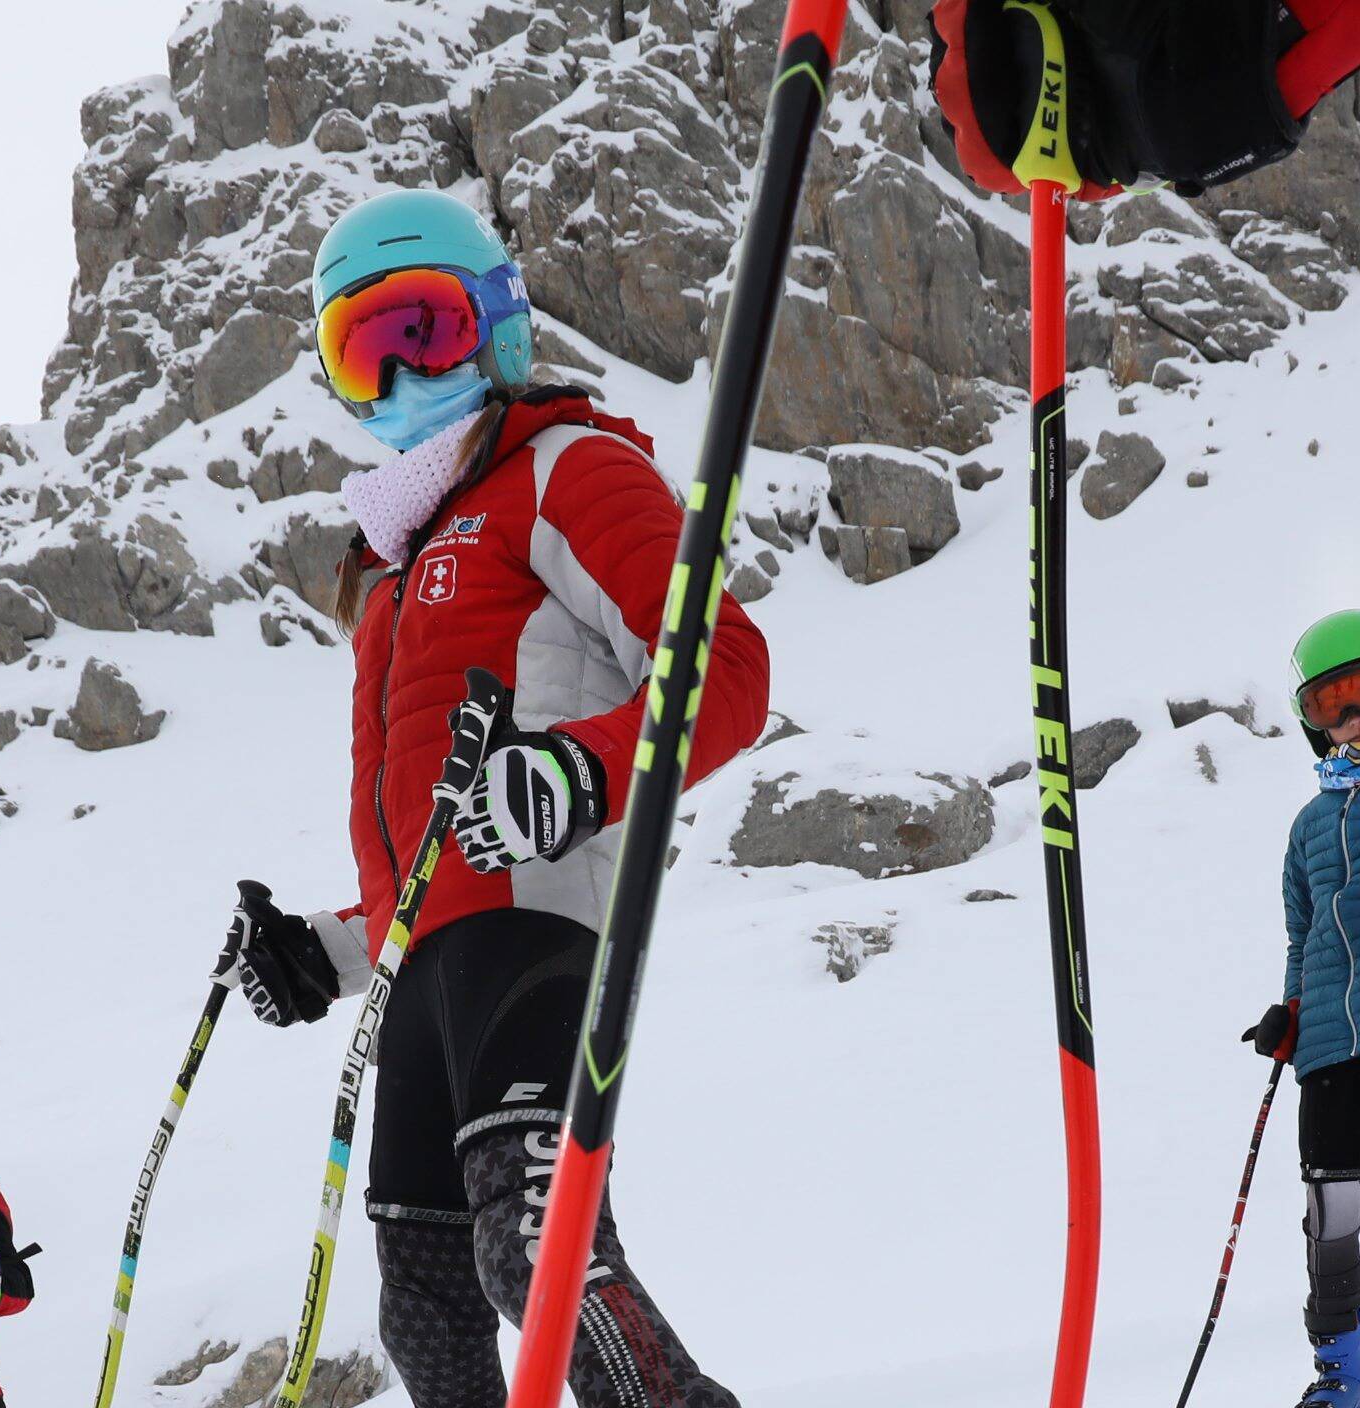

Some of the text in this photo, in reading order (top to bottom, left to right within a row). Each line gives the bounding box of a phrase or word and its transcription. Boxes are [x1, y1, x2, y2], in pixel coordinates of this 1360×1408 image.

[1039, 60, 1062, 158] LEKI
[561, 738, 593, 792] SCOTT
[1031, 663, 1075, 851] LEKI
[540, 794, 556, 849] reusch
[340, 976, 390, 1113] SCOTT
[129, 1128, 169, 1231] SCOTT
